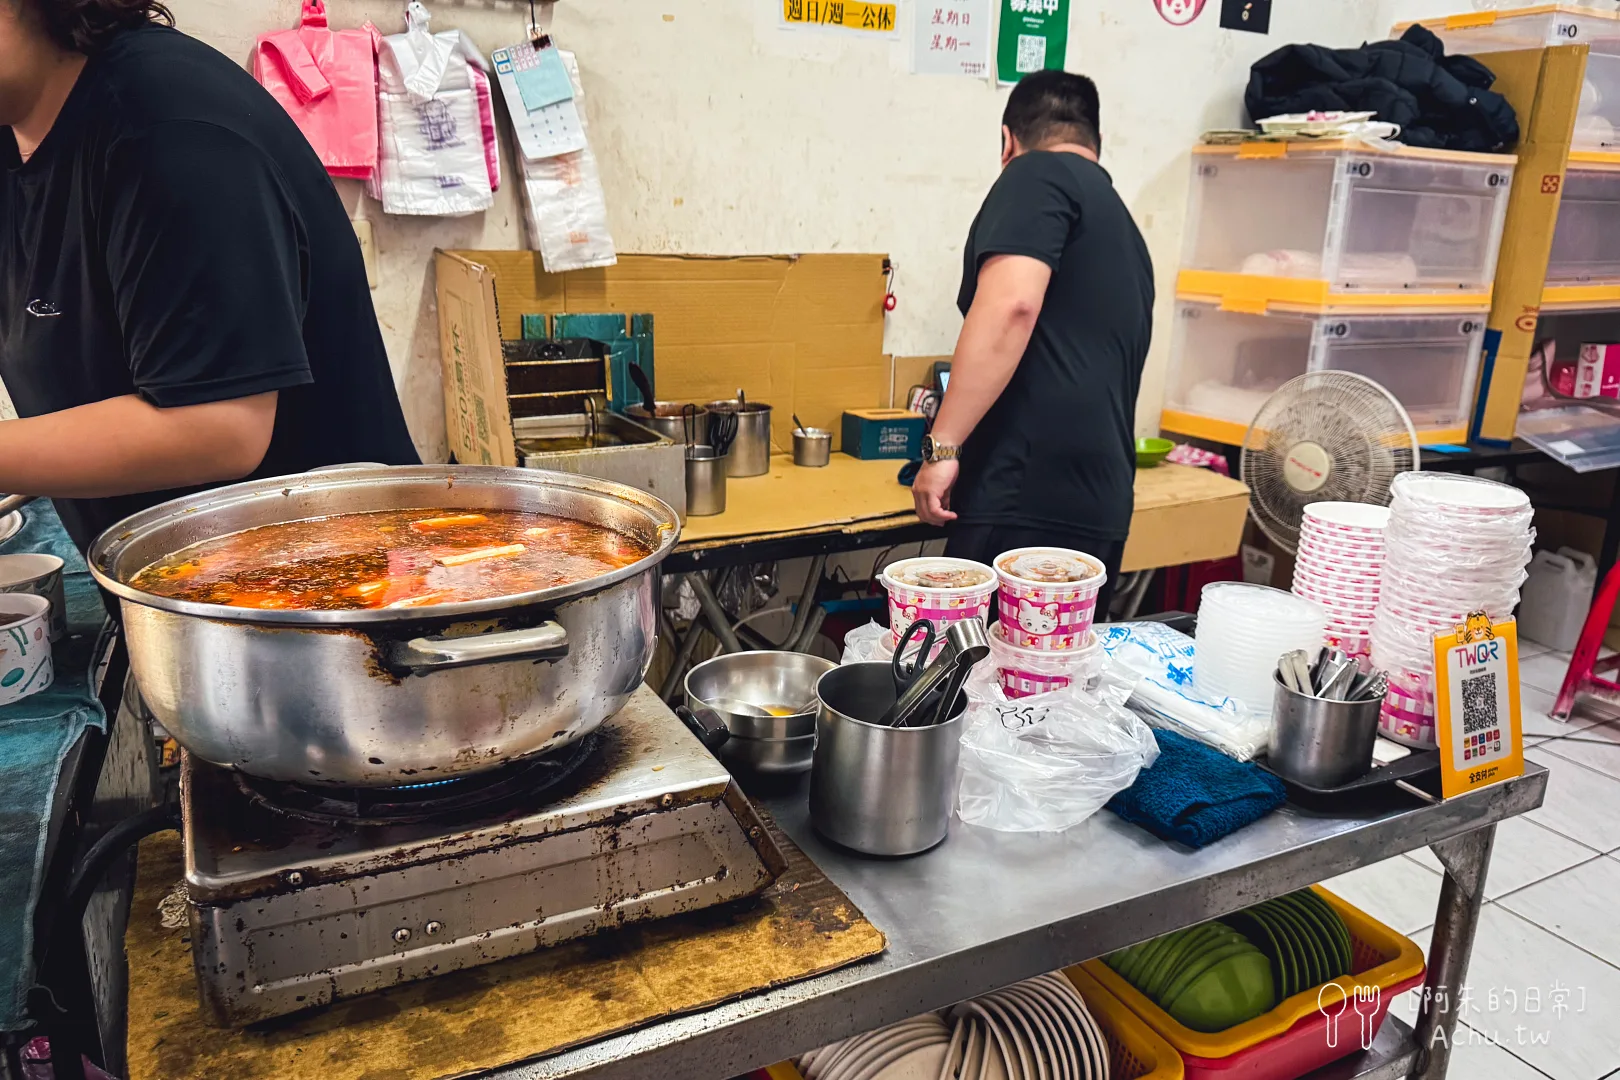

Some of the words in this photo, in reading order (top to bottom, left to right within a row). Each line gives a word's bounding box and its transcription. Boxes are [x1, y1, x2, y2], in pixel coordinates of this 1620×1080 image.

[788, 0, 891, 29] 週日/週一公休
[931, 8, 971, 25] 星期日
[930, 34, 971, 51] 星期一
[1455, 641, 1499, 668] TWQR
